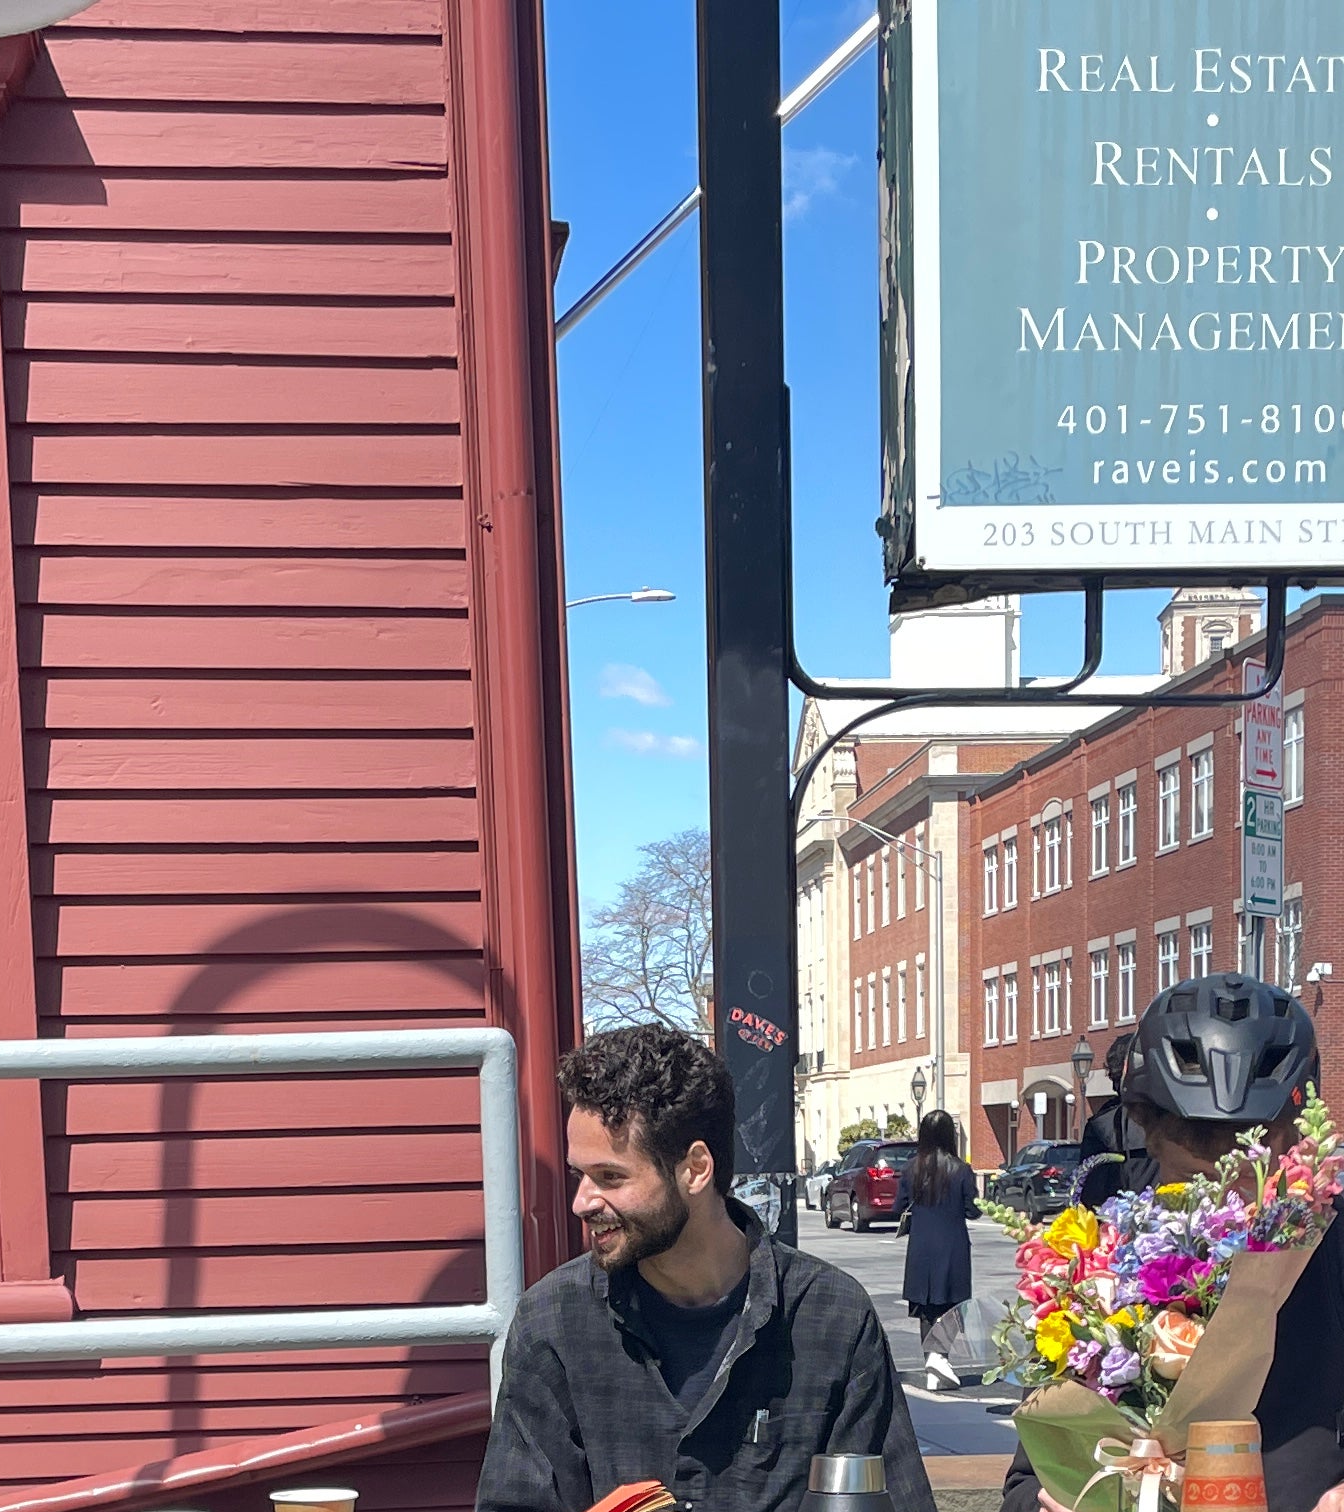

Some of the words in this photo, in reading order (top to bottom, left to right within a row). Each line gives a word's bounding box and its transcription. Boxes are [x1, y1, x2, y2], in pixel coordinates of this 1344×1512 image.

[1036, 48, 1175, 94] REAL
[1092, 140, 1334, 187] RENTALS
[1092, 449, 1327, 485] raveis.com
[982, 521, 1036, 548] 203
[1050, 520, 1173, 547] SOUTH
[1188, 519, 1283, 545] MAIN
[1245, 703, 1282, 729] PARKING
[1256, 729, 1272, 746] ANY
[1254, 746, 1274, 766] TIME
[1246, 795, 1256, 828] 2
[1263, 799, 1275, 817] HR
[1256, 819, 1281, 837] PARKING
[1266, 844, 1277, 858] AM
[1259, 859, 1267, 874] TO
[730, 1006, 786, 1045] DAVES
